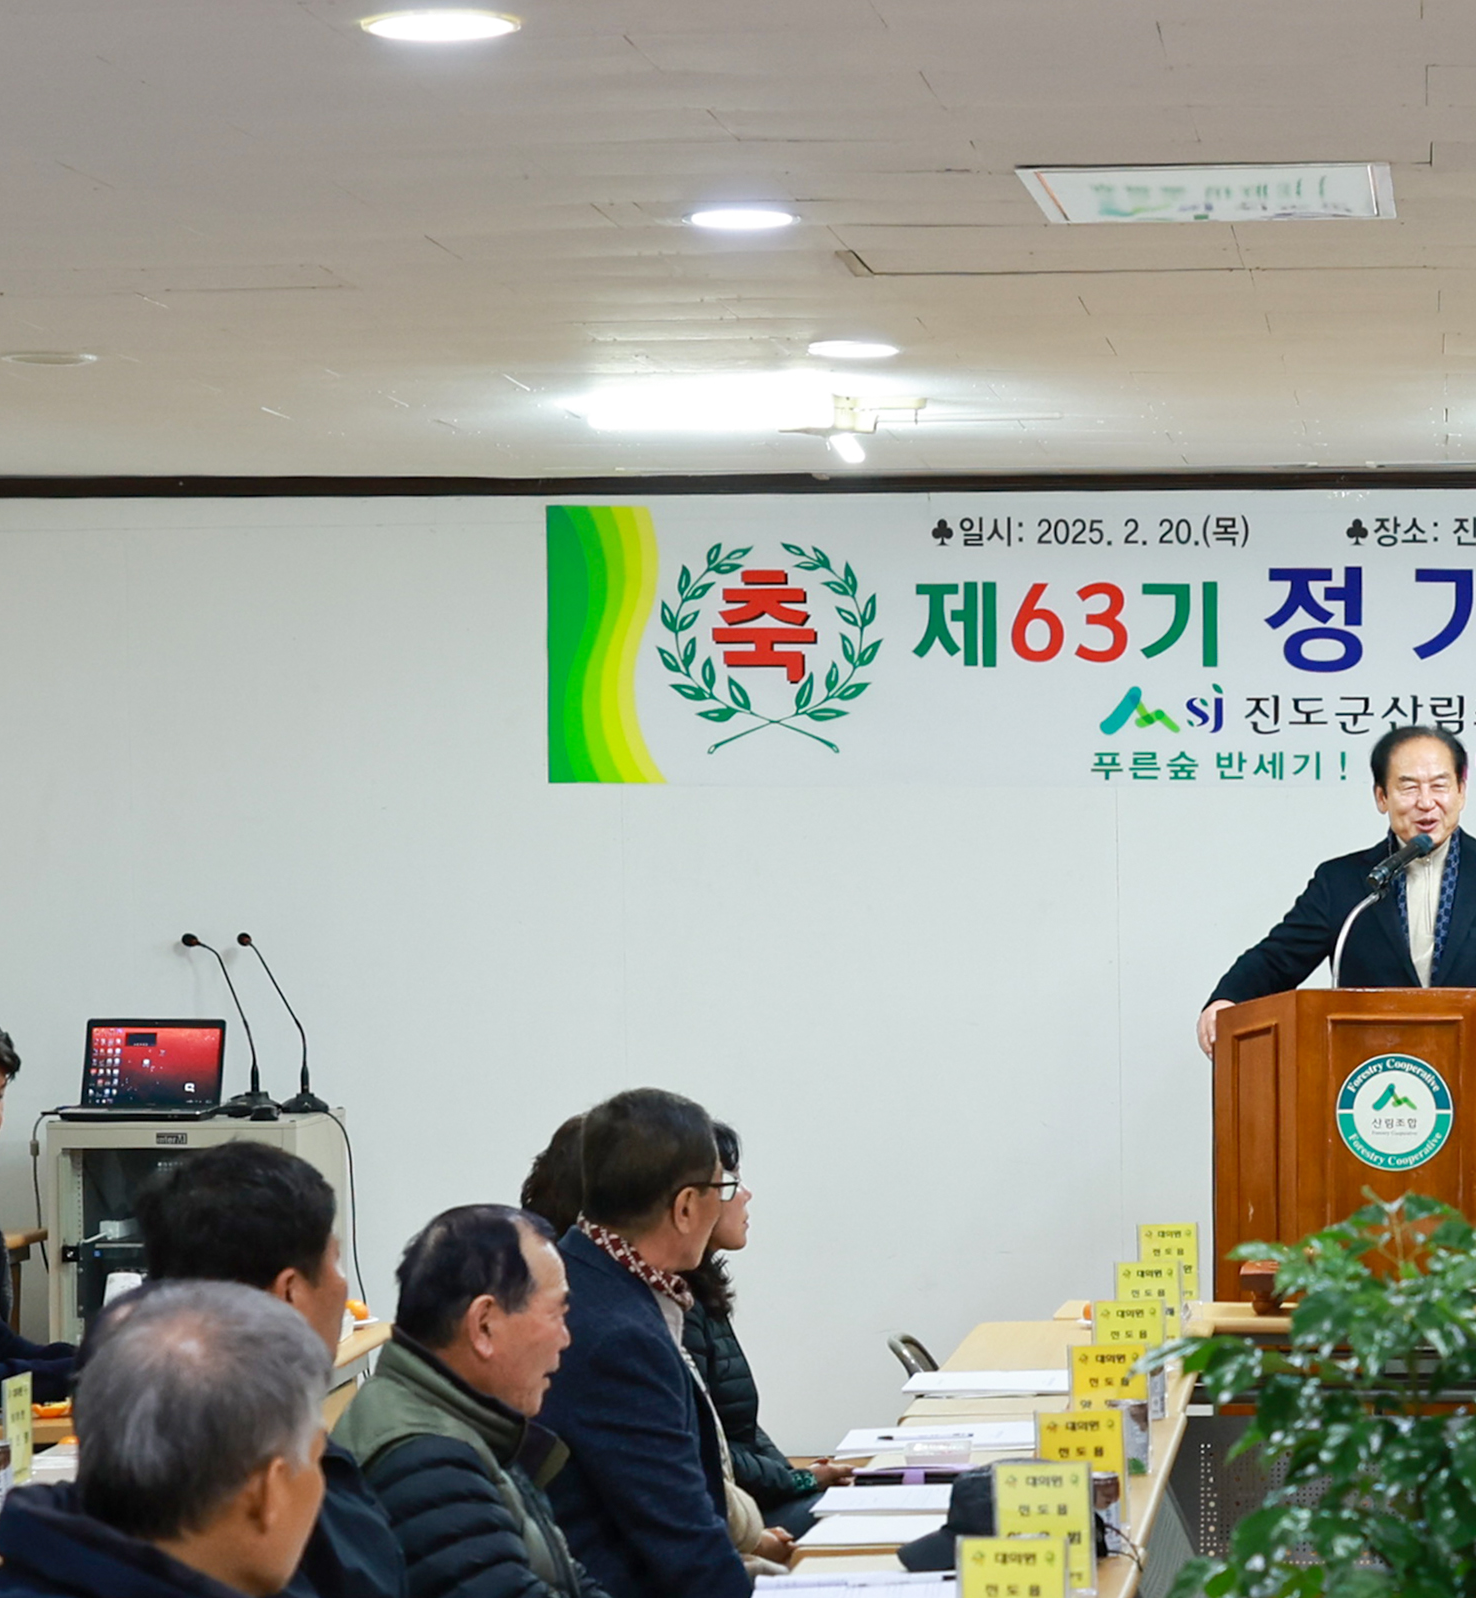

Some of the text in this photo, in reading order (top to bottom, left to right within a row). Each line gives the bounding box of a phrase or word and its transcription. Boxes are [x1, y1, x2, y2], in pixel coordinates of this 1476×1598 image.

[960, 515, 1249, 547] 일시: 2025. 2. 20.(목)
[1374, 516, 1438, 547] 장소:
[711, 569, 818, 684] 축
[912, 581, 1218, 667] 제63기
[1091, 751, 1198, 780] 푸른숲
[1346, 1058, 1440, 1093] Forestry Cooperative
[1372, 1118, 1417, 1129] 산림조합
[1348, 1132, 1442, 1166] Forestry Cooperative
